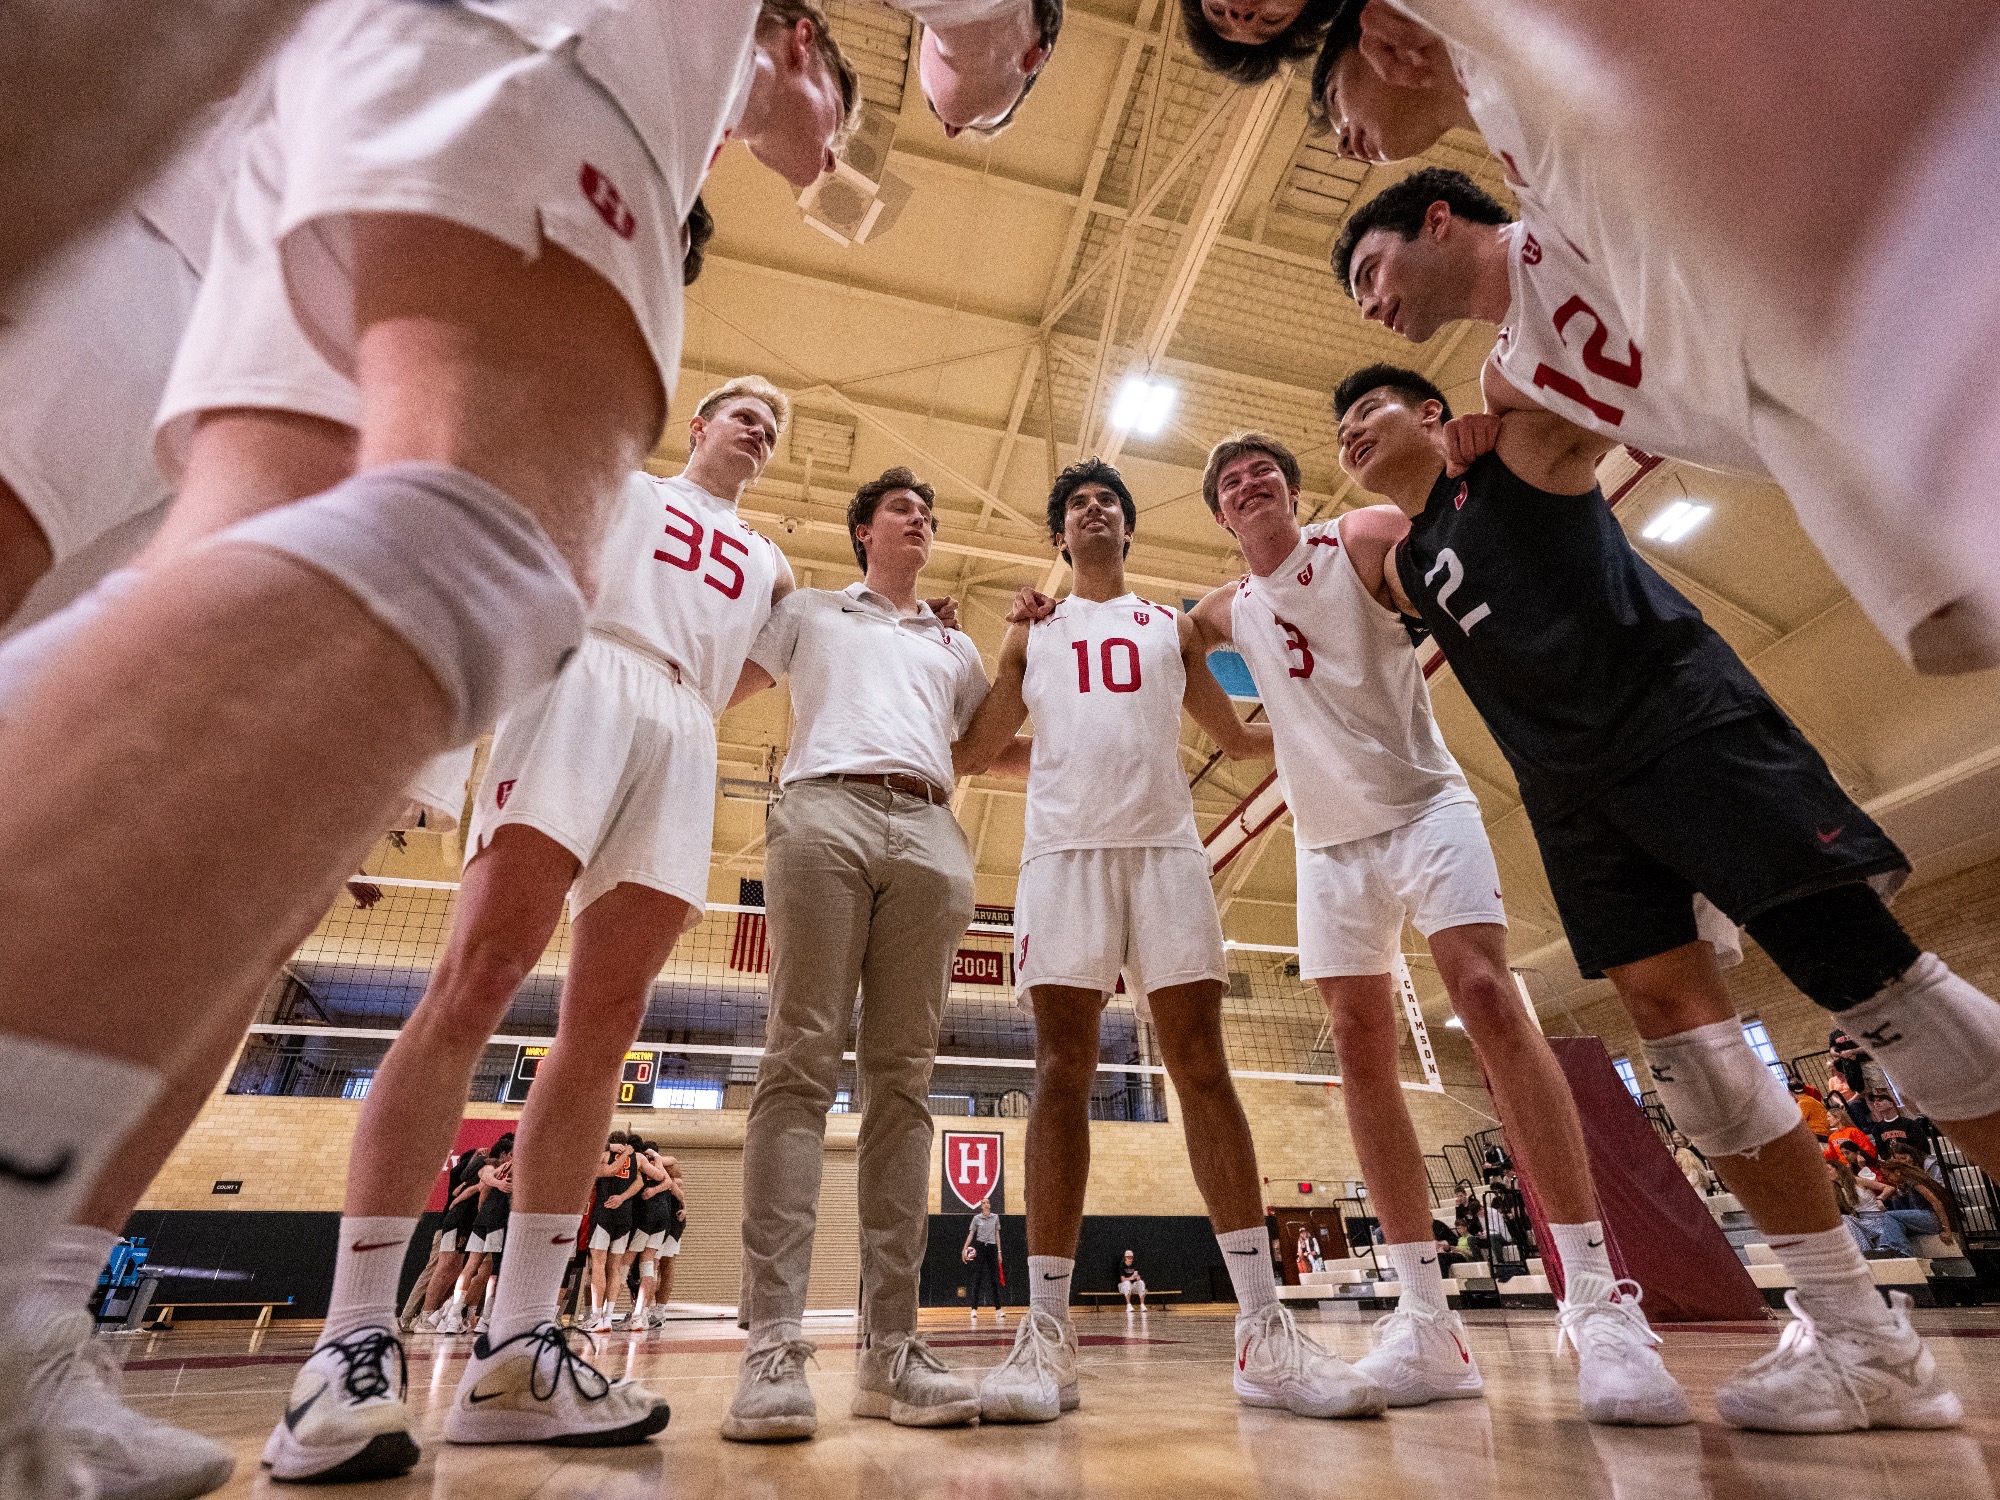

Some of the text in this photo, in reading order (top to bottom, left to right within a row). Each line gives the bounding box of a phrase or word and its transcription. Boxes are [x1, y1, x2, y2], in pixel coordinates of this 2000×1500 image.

[1533, 295, 1642, 426] 12
[653, 504, 749, 600] 35
[1425, 547, 1492, 637] 2
[1071, 638, 1142, 693] 10
[1275, 613, 1315, 679] 3
[974, 911, 1010, 921] ARVARD
[953, 957, 998, 978] 2004
[1404, 980, 1437, 1074] CRIMSON
[620, 1083, 635, 1102] 0
[636, 1063, 650, 1081] 0
[958, 1142, 988, 1185] H
